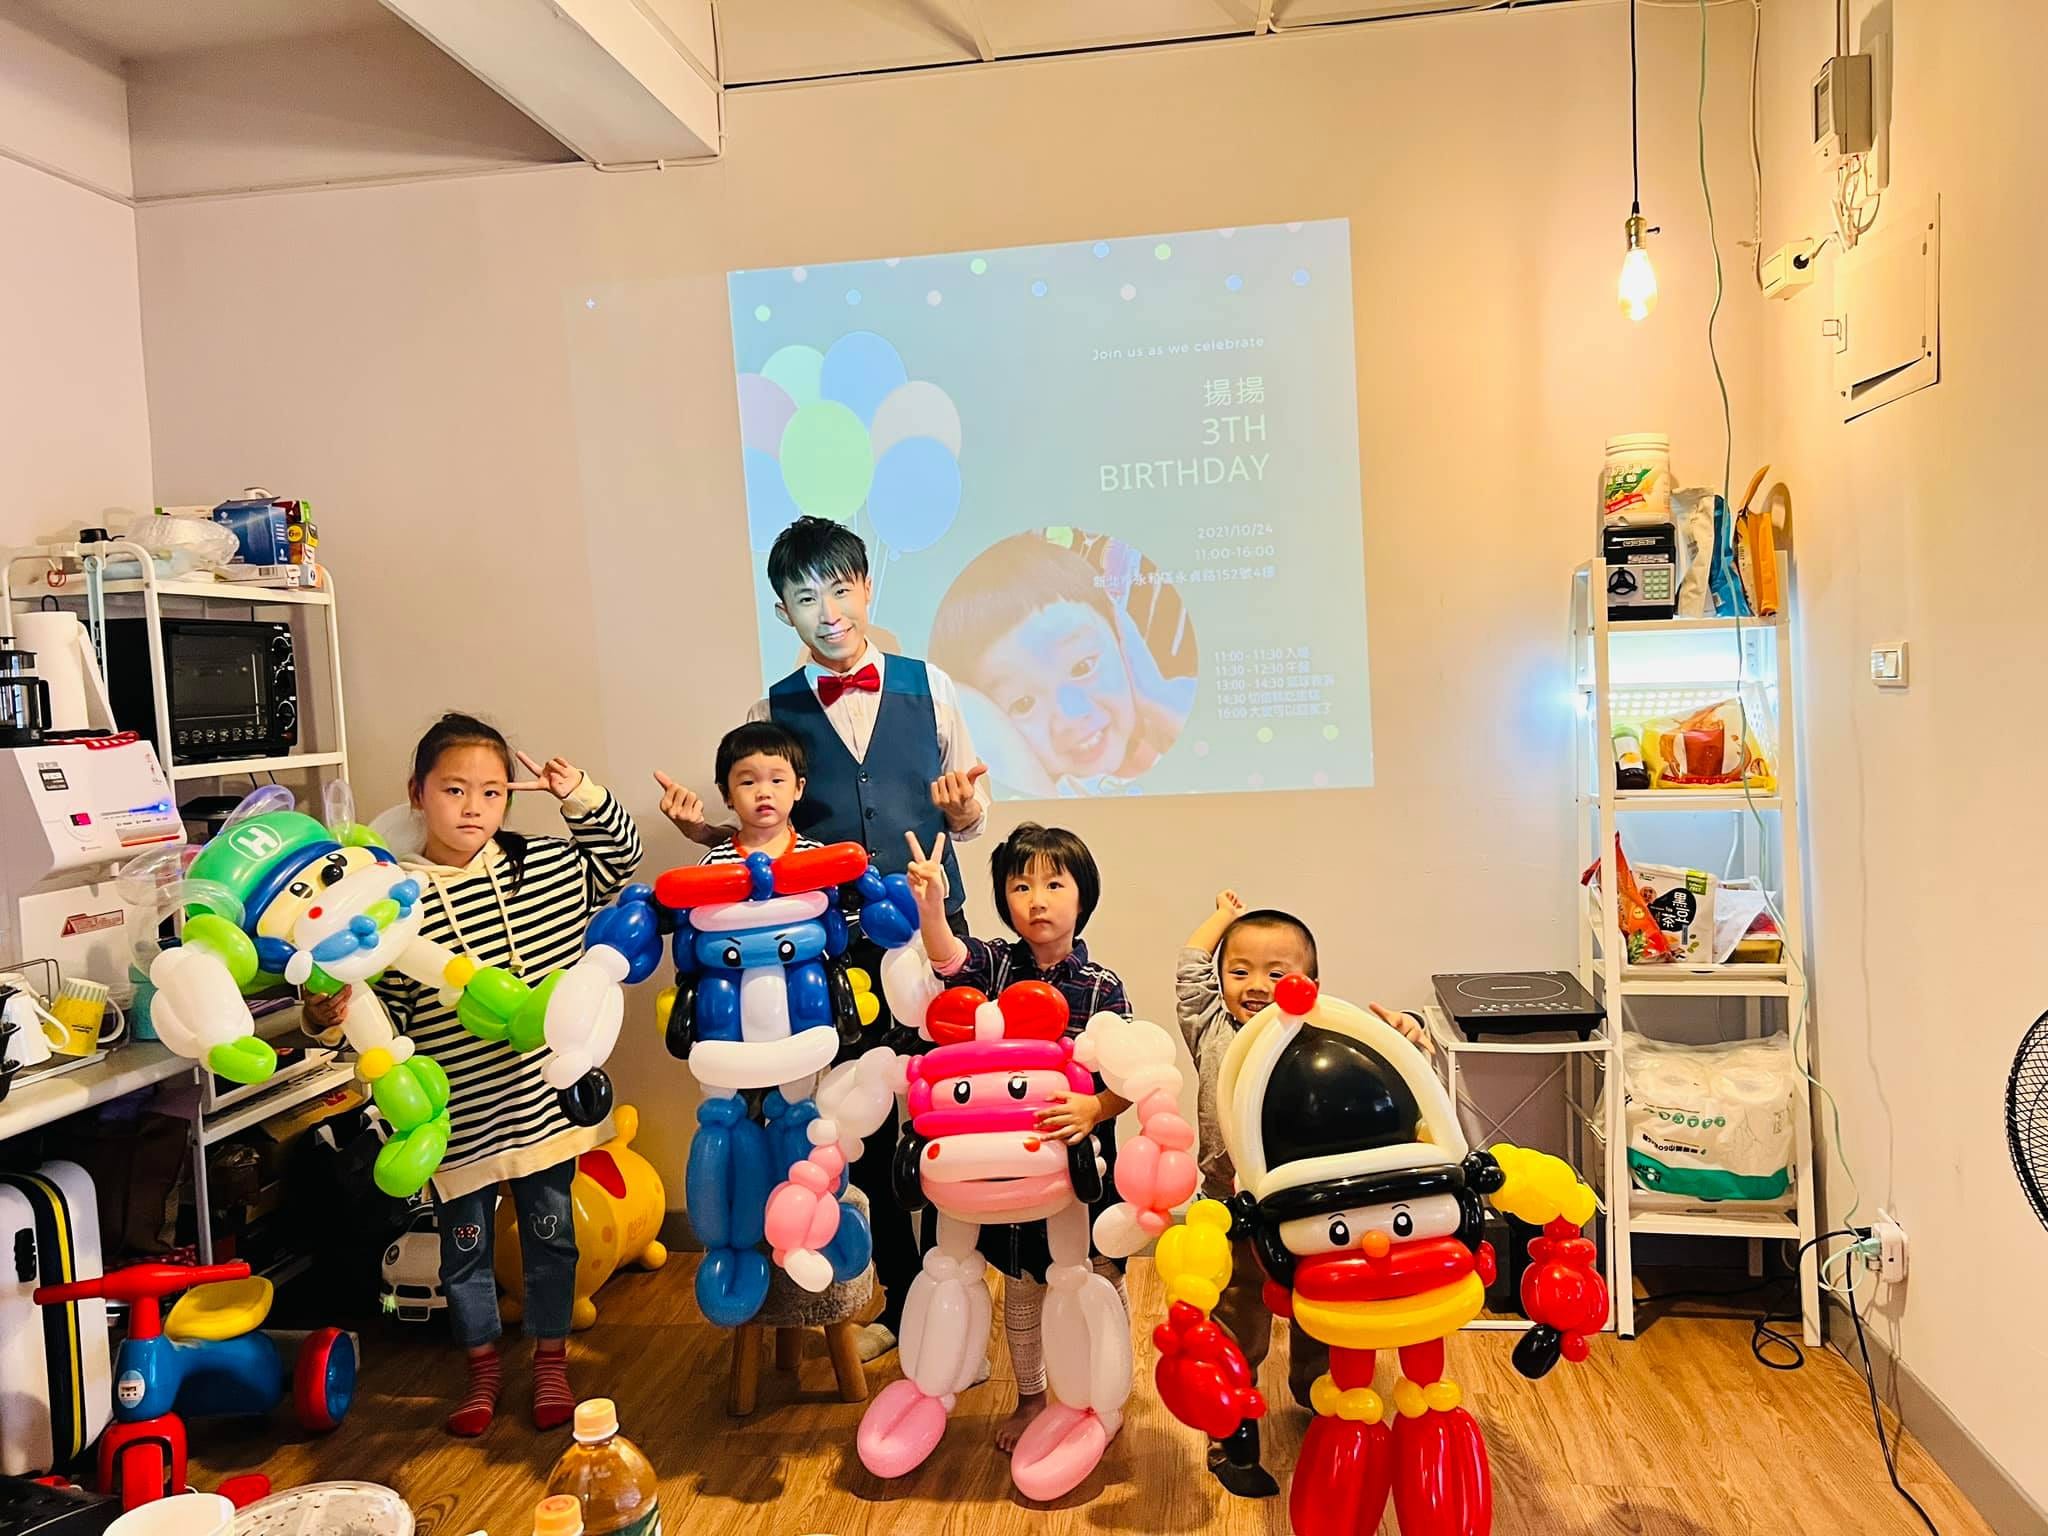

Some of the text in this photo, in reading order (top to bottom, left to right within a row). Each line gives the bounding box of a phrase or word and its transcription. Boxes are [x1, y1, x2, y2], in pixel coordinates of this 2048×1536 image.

[1092, 337, 1264, 360] Join us as we celebrate
[1204, 376, 1265, 407] 揚揚
[1202, 414, 1266, 445] 3TH
[1100, 453, 1270, 492] BIRTHDAY
[1197, 524, 1273, 539] 2021/10/24
[237, 827, 279, 857] H
